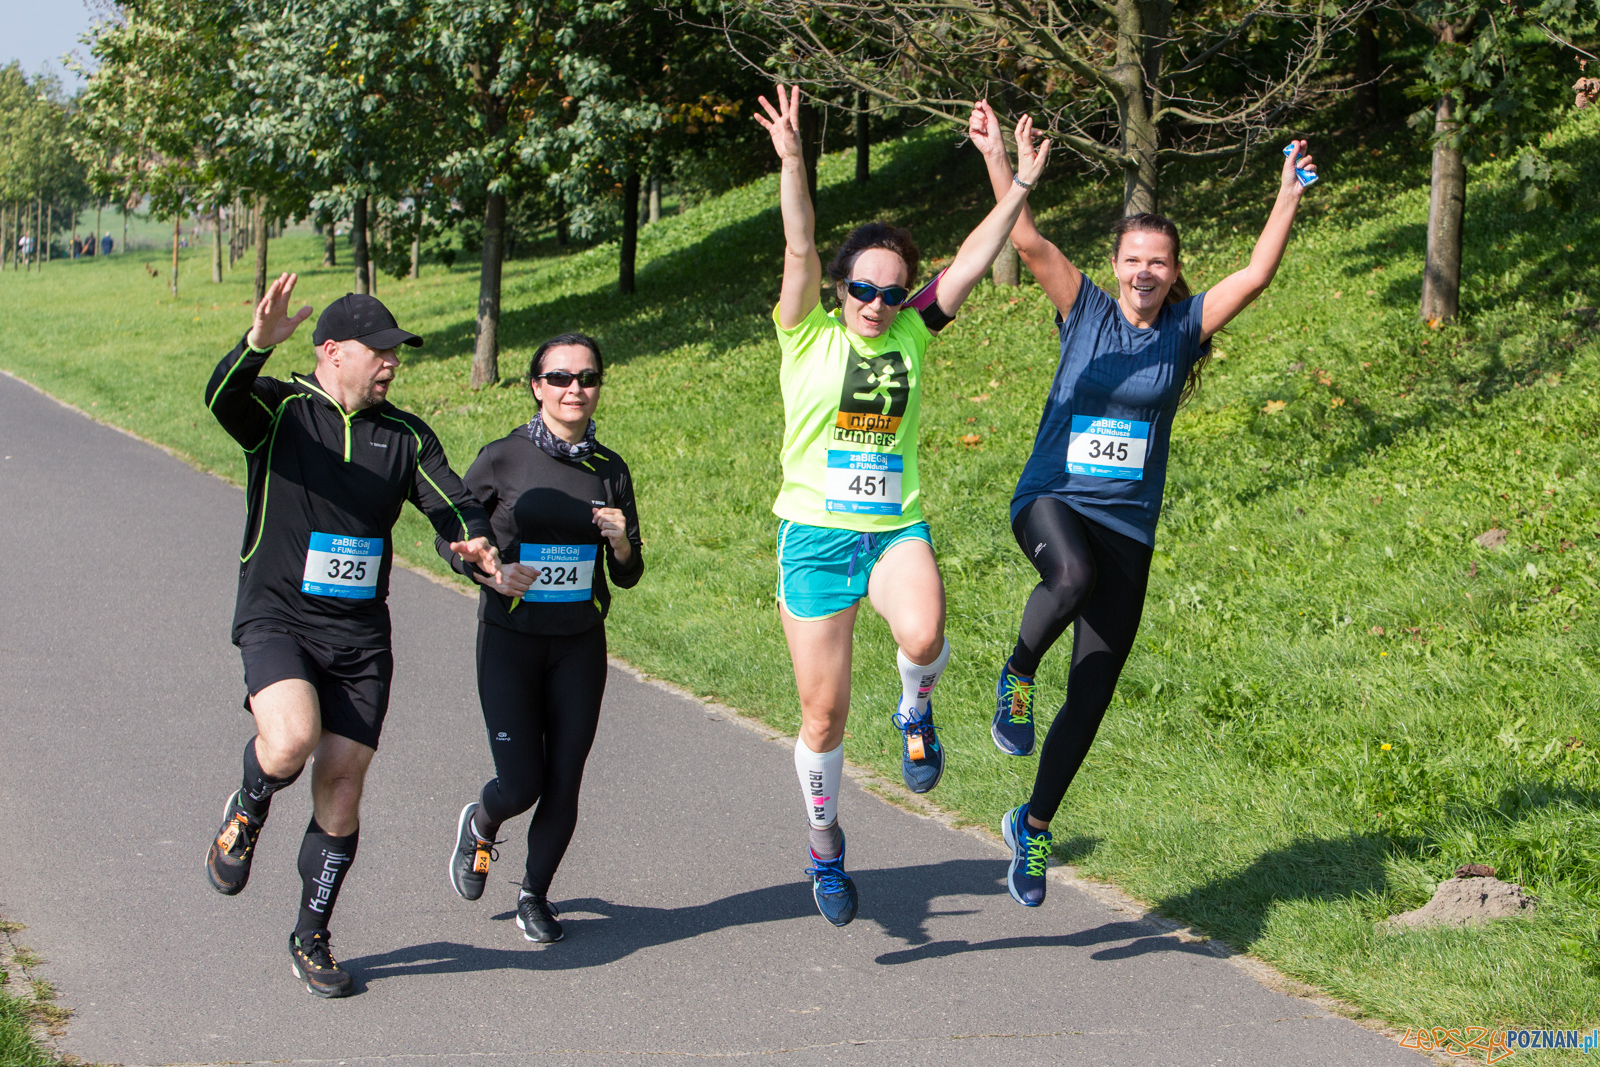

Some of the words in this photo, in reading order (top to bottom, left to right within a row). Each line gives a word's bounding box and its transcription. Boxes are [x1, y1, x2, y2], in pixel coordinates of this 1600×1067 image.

[850, 414, 892, 430] night
[1091, 419, 1132, 432] zaBIEGaj
[834, 427, 896, 446] runners
[1096, 428, 1130, 437] FUNdusze
[850, 453, 888, 465] zaBIEGaj
[1088, 440, 1128, 462] 345
[856, 462, 888, 470] FUNdusze
[848, 475, 886, 496] 451
[332, 538, 370, 550] zaBIEGaj
[336, 546, 369, 555] FUNdusze
[540, 546, 580, 556] zaBIEGaj
[328, 558, 367, 580] 325
[540, 566, 578, 585] 324
[809, 770, 830, 820] IRONMAN
[221, 830, 238, 850] 325
